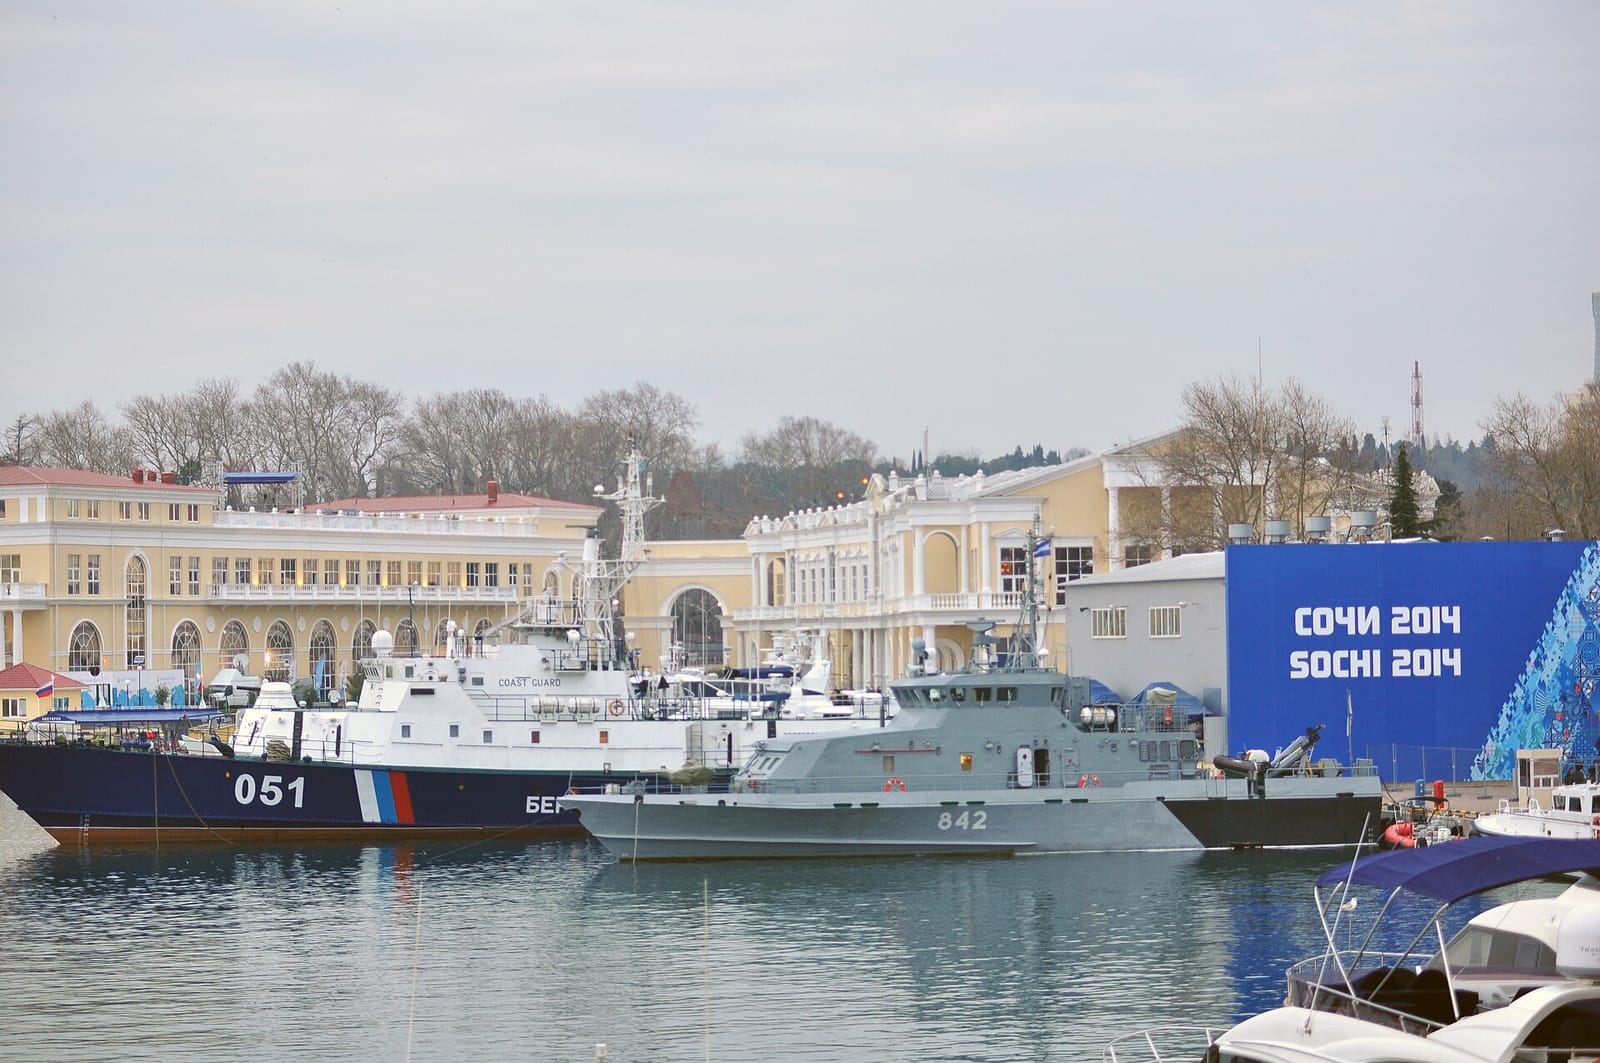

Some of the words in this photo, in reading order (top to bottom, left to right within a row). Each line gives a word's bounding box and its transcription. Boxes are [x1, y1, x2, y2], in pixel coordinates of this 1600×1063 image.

[1295, 606, 1380, 636] СОЧИ
[1391, 605, 1461, 634] 2014
[1290, 649, 1381, 679] SOCHI
[1392, 648, 1462, 677] 2014
[498, 678, 527, 687] COAST
[531, 678, 561, 687] GUARD
[234, 773, 305, 808] 051
[937, 810, 987, 830] 842
